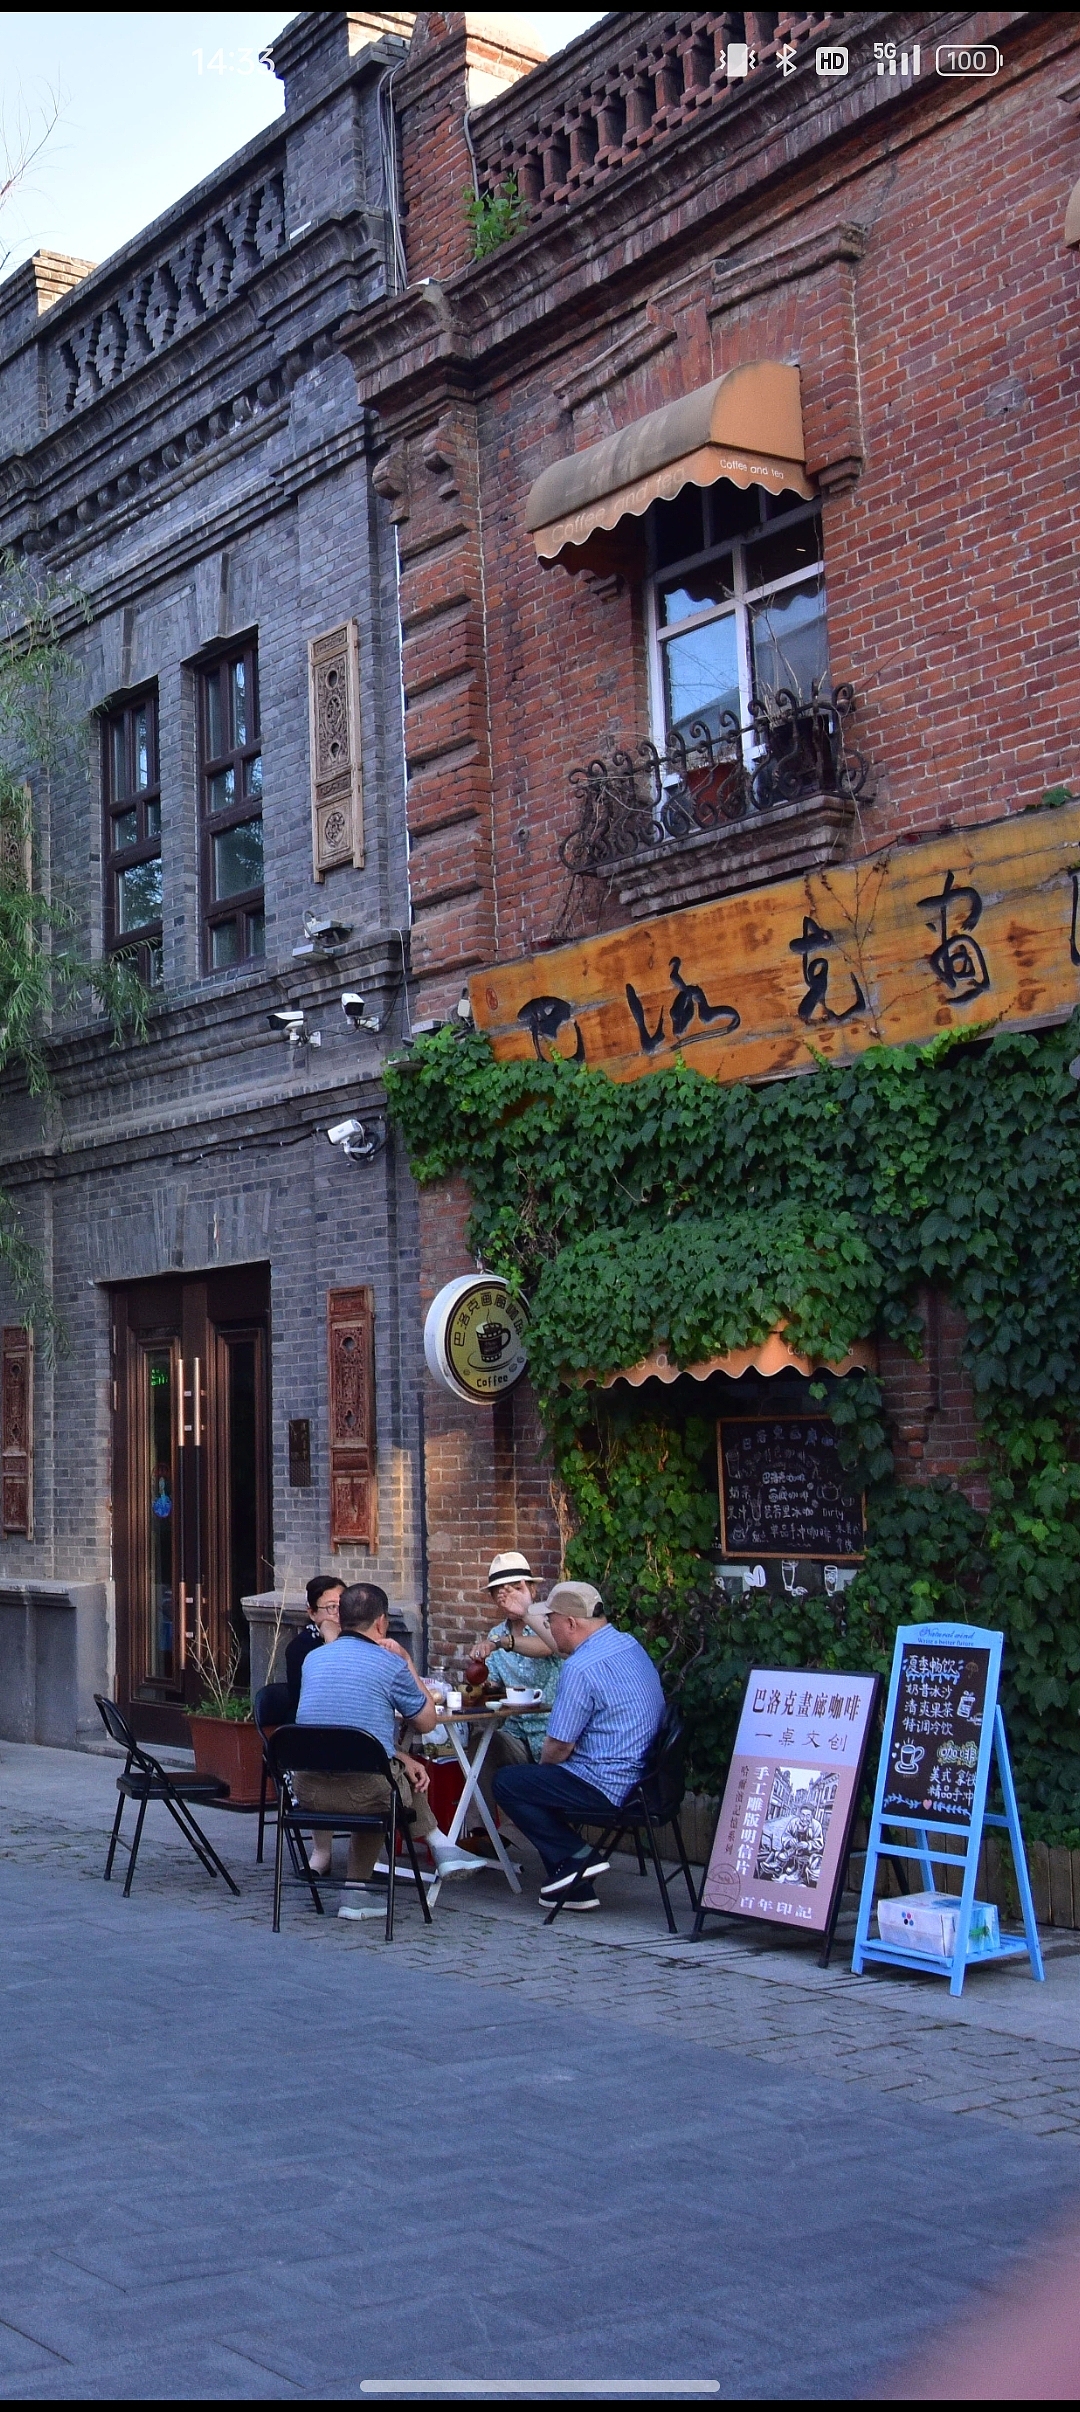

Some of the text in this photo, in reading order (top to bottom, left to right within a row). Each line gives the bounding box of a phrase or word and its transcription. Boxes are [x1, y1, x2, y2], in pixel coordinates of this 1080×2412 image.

[720, 459, 748, 473] Coffee
[750, 466, 769, 475] and
[552, 466, 686, 543] Coffee and tea
[476, 1374, 509, 1389] Coffee
[822, 1507, 844, 1521] Dirty
[909, 1655, 958, 1675] 夏季畅饮
[904, 1698, 955, 1718] 清爽果茶
[902, 1716, 954, 1737] 特调冷饮
[940, 1746, 977, 1761] 咖啡
[929, 1765, 952, 1784] 美式
[734, 1765, 771, 1877] 手工雕版明信片
